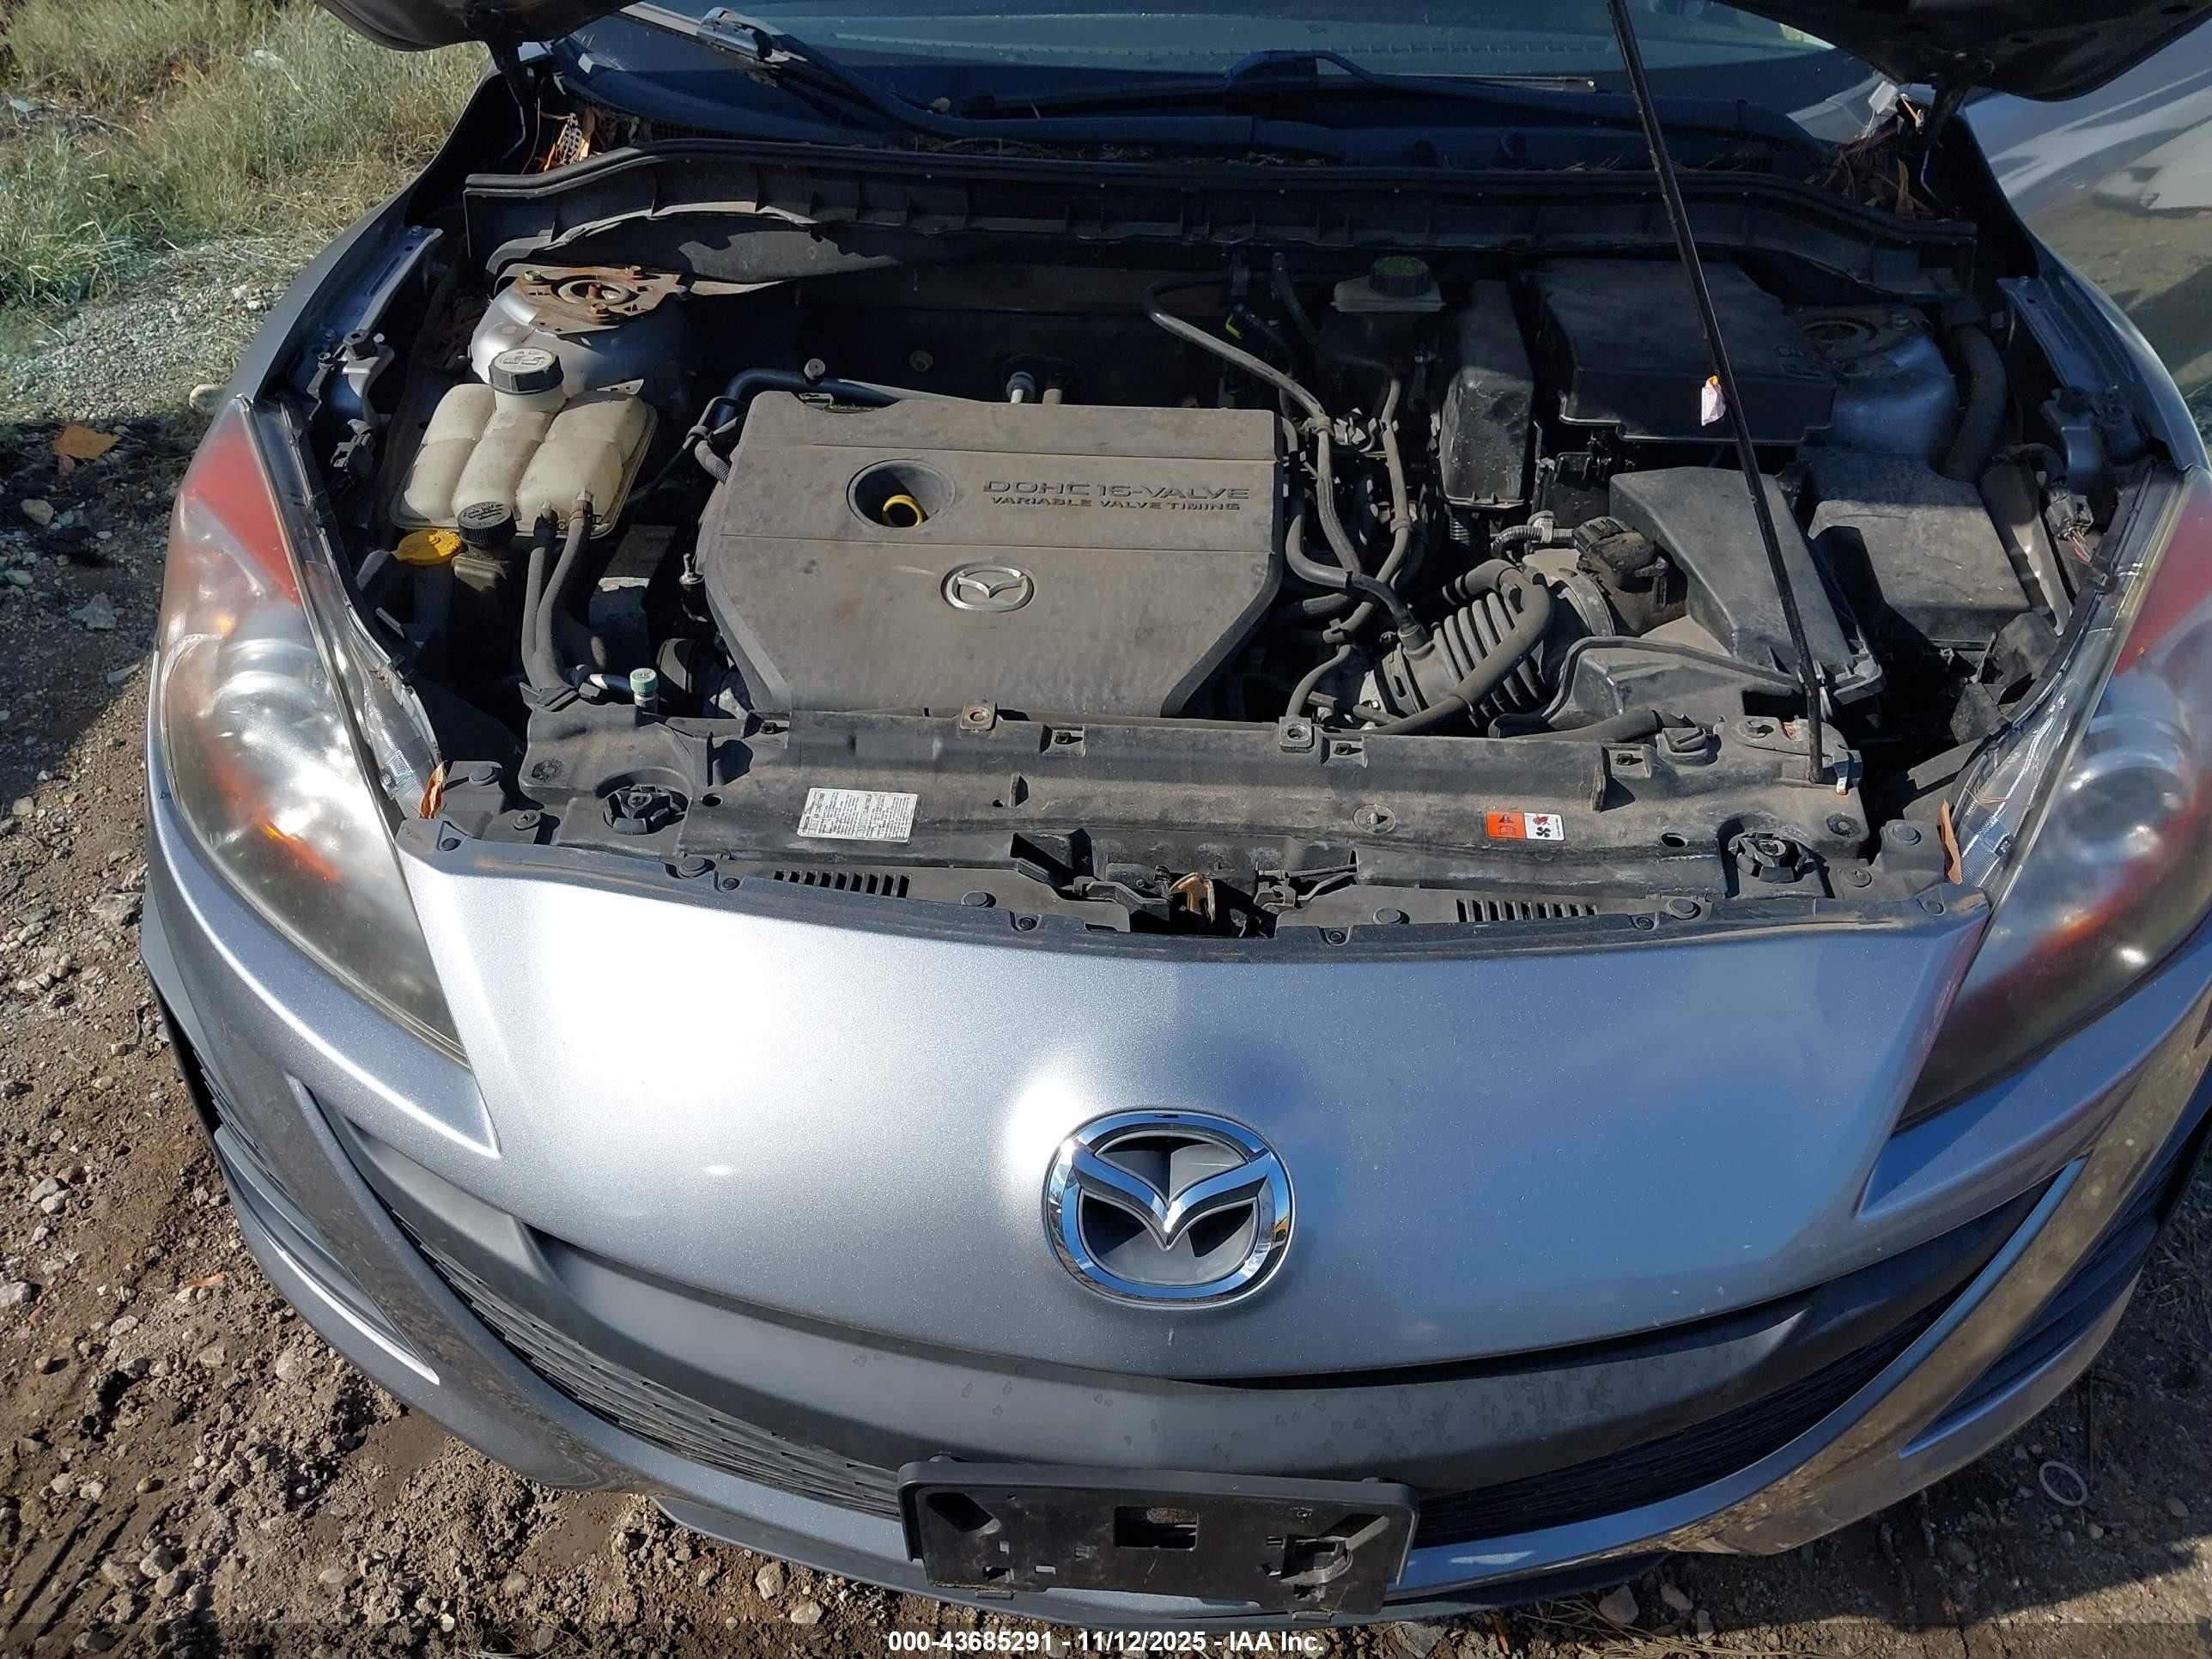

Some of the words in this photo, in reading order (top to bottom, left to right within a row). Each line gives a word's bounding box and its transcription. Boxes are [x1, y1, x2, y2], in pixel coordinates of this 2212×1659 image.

[983, 481, 1091, 495] DOHC
[1097, 484, 1249, 500] 16-VALVE
[992, 496, 1092, 508] VARIABLE
[1099, 500, 1162, 510] VALVE
[1167, 502, 1241, 511] TIMING
